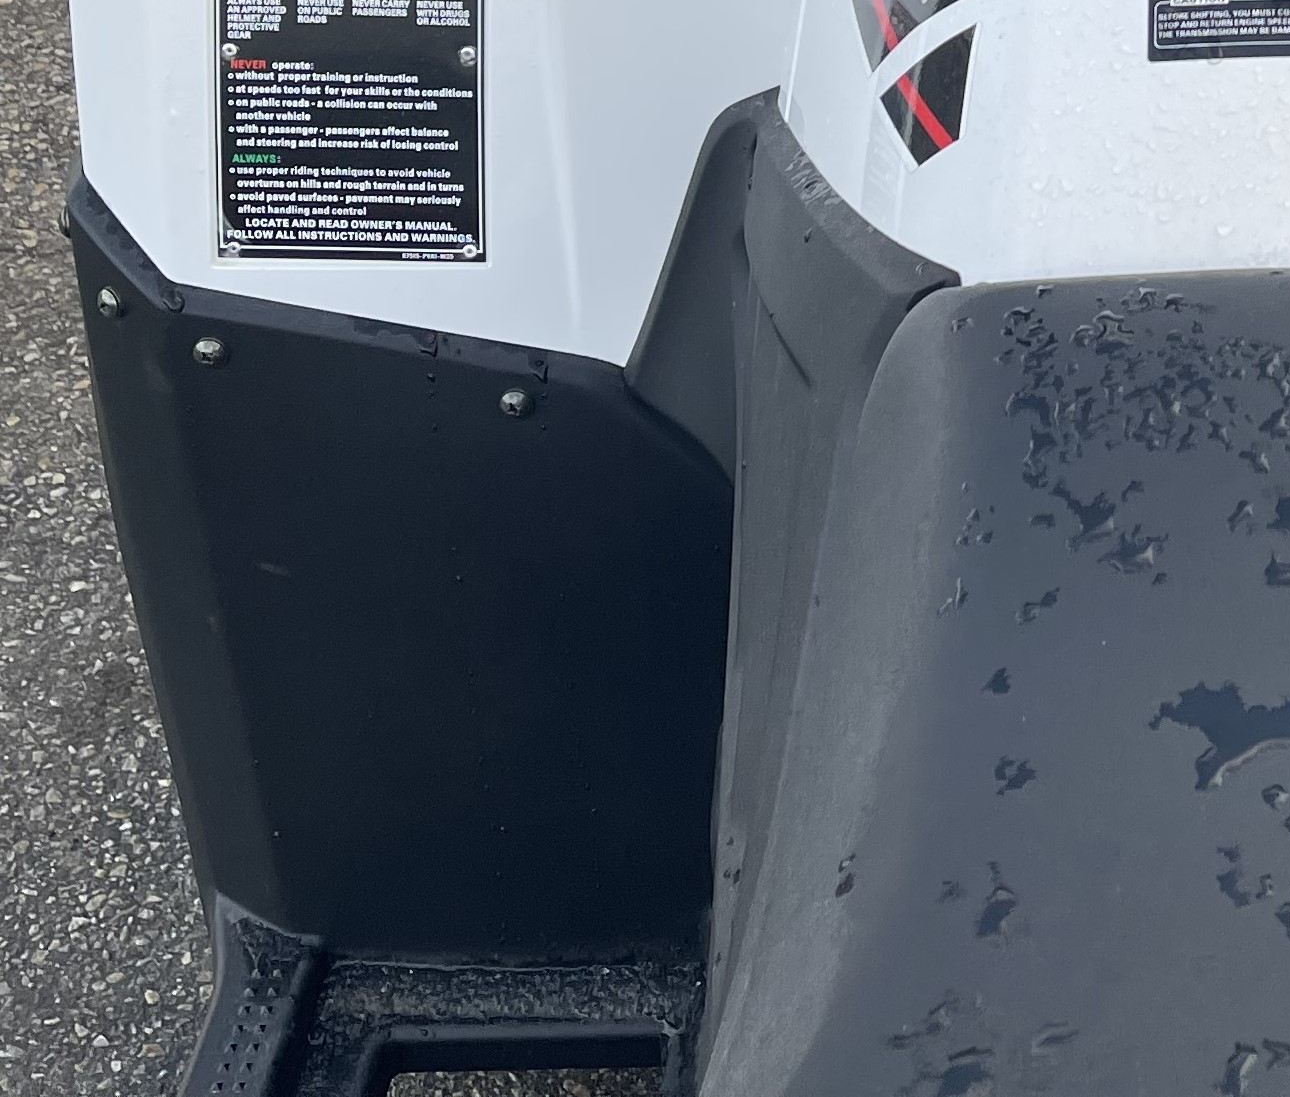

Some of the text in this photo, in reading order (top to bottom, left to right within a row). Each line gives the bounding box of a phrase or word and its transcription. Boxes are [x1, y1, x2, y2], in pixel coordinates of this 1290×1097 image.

[352, 0, 410, 8] NEVER CARRY
[417, 1, 463, 9] NEVER USE
[227, 6, 286, 15] AN APPROVED
[297, 7, 342, 15] ON PUBLIC
[352, 8, 407, 17] PASSENGERS
[417, 9, 470, 18] WITH DRUGS
[227, 15, 281, 23] HELMET AND
[297, 15, 327, 24] ROADS
[431, 18, 470, 27] ALCOHOL
[227, 23, 279, 31] PROTECTIVE
[227, 31, 251, 39] GEAR
[230, 60, 314, 71] NEVER operate:
[236, 72, 274, 81] without
[278, 74, 310, 83] proper
[312, 73, 350, 83] training
[365, 74, 418, 83] instruction
[248, 85, 281, 95] speeds
[284, 86, 299, 94] too
[302, 86, 321, 94] fast
[324, 86, 339, 95] for
[341, 88, 363, 97] your
[365, 87, 390, 96] skills
[404, 88, 420, 96] the
[422, 88, 473, 97] conditions
[232, 154, 281, 163] ALWAYS:
[238, 206, 366, 216] affect handling and control
[245, 218, 457, 231] LOCATE AND READ OWNER'S MANUAL.
[227, 230, 476, 243] FOLLOW ALL INSTRUCTIONS AND WARNINGS.
